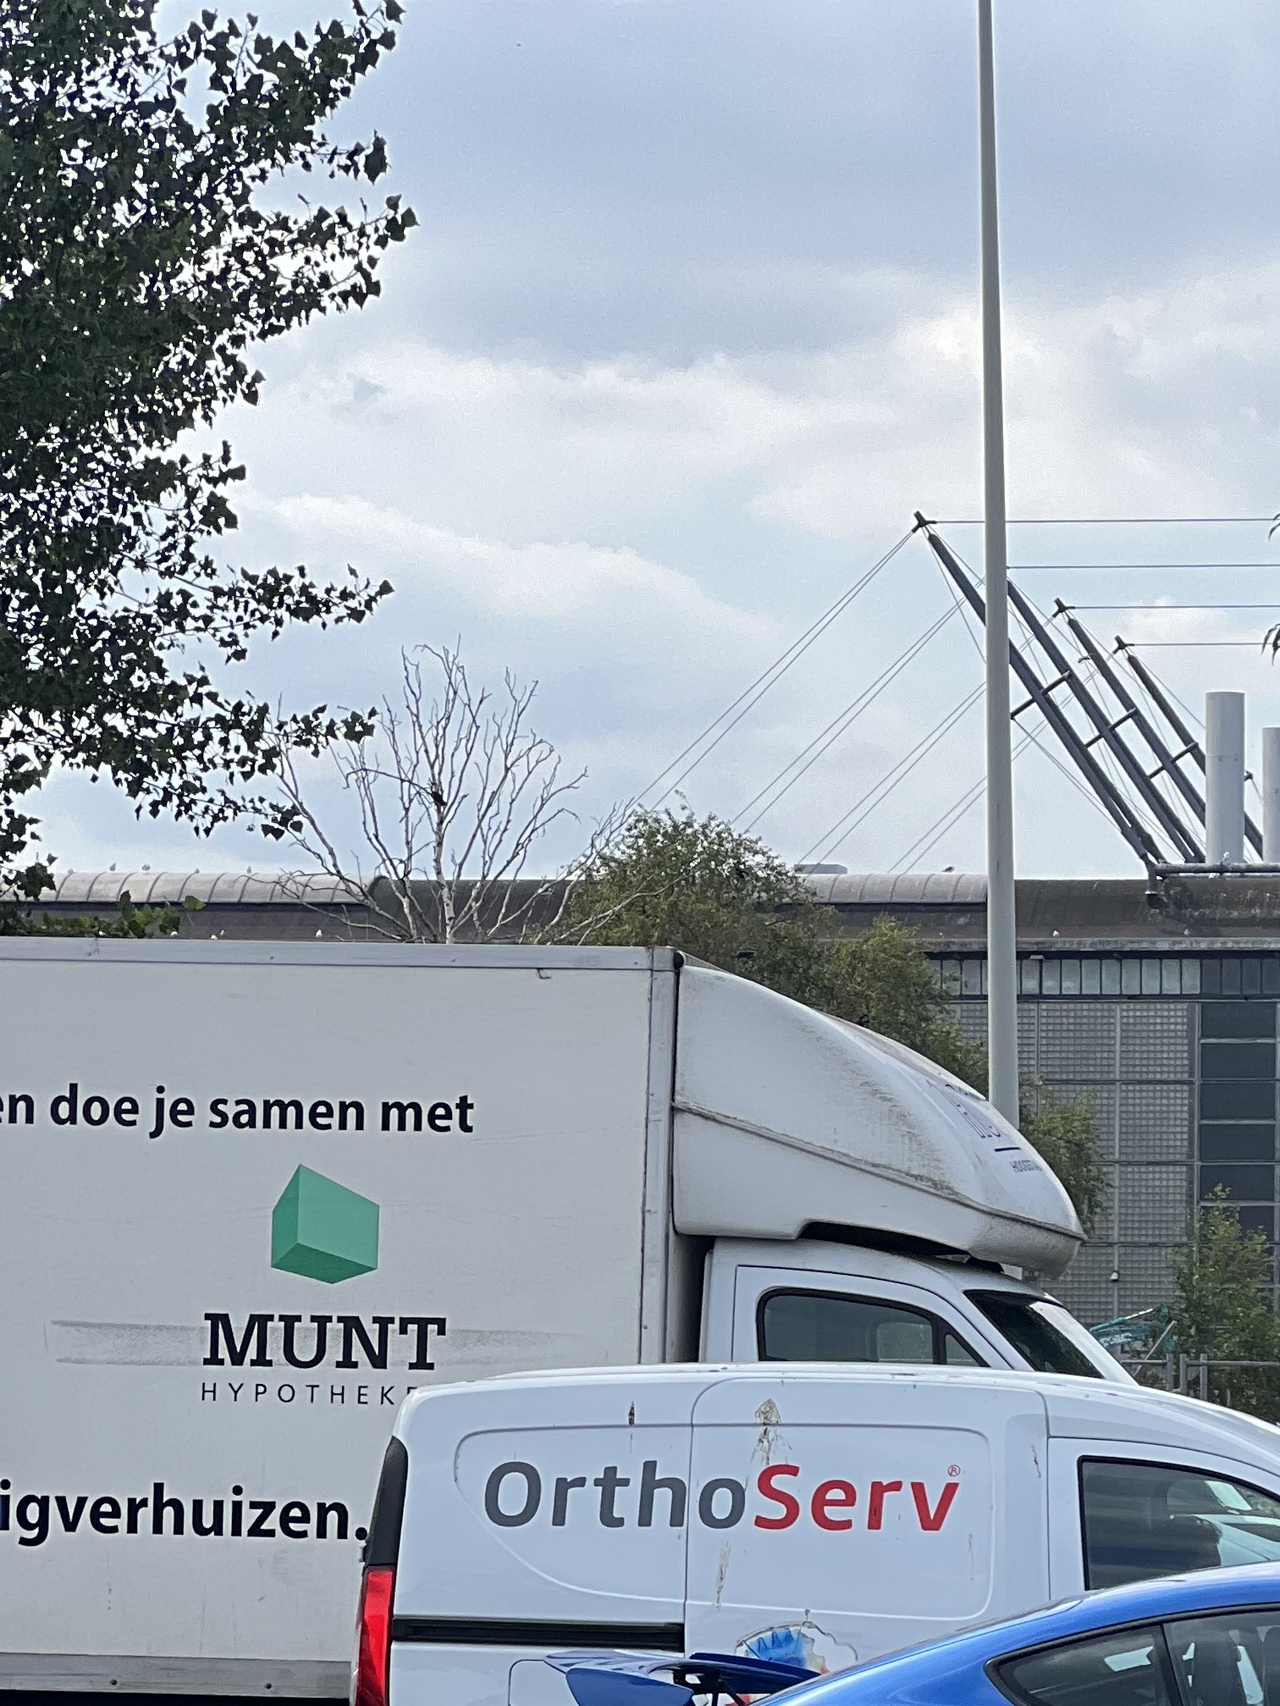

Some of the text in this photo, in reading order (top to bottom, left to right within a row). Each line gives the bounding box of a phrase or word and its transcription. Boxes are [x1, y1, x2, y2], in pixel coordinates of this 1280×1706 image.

[0, 1083, 474, 1139] n doe je samen met
[203, 1313, 446, 1371] MUNT
